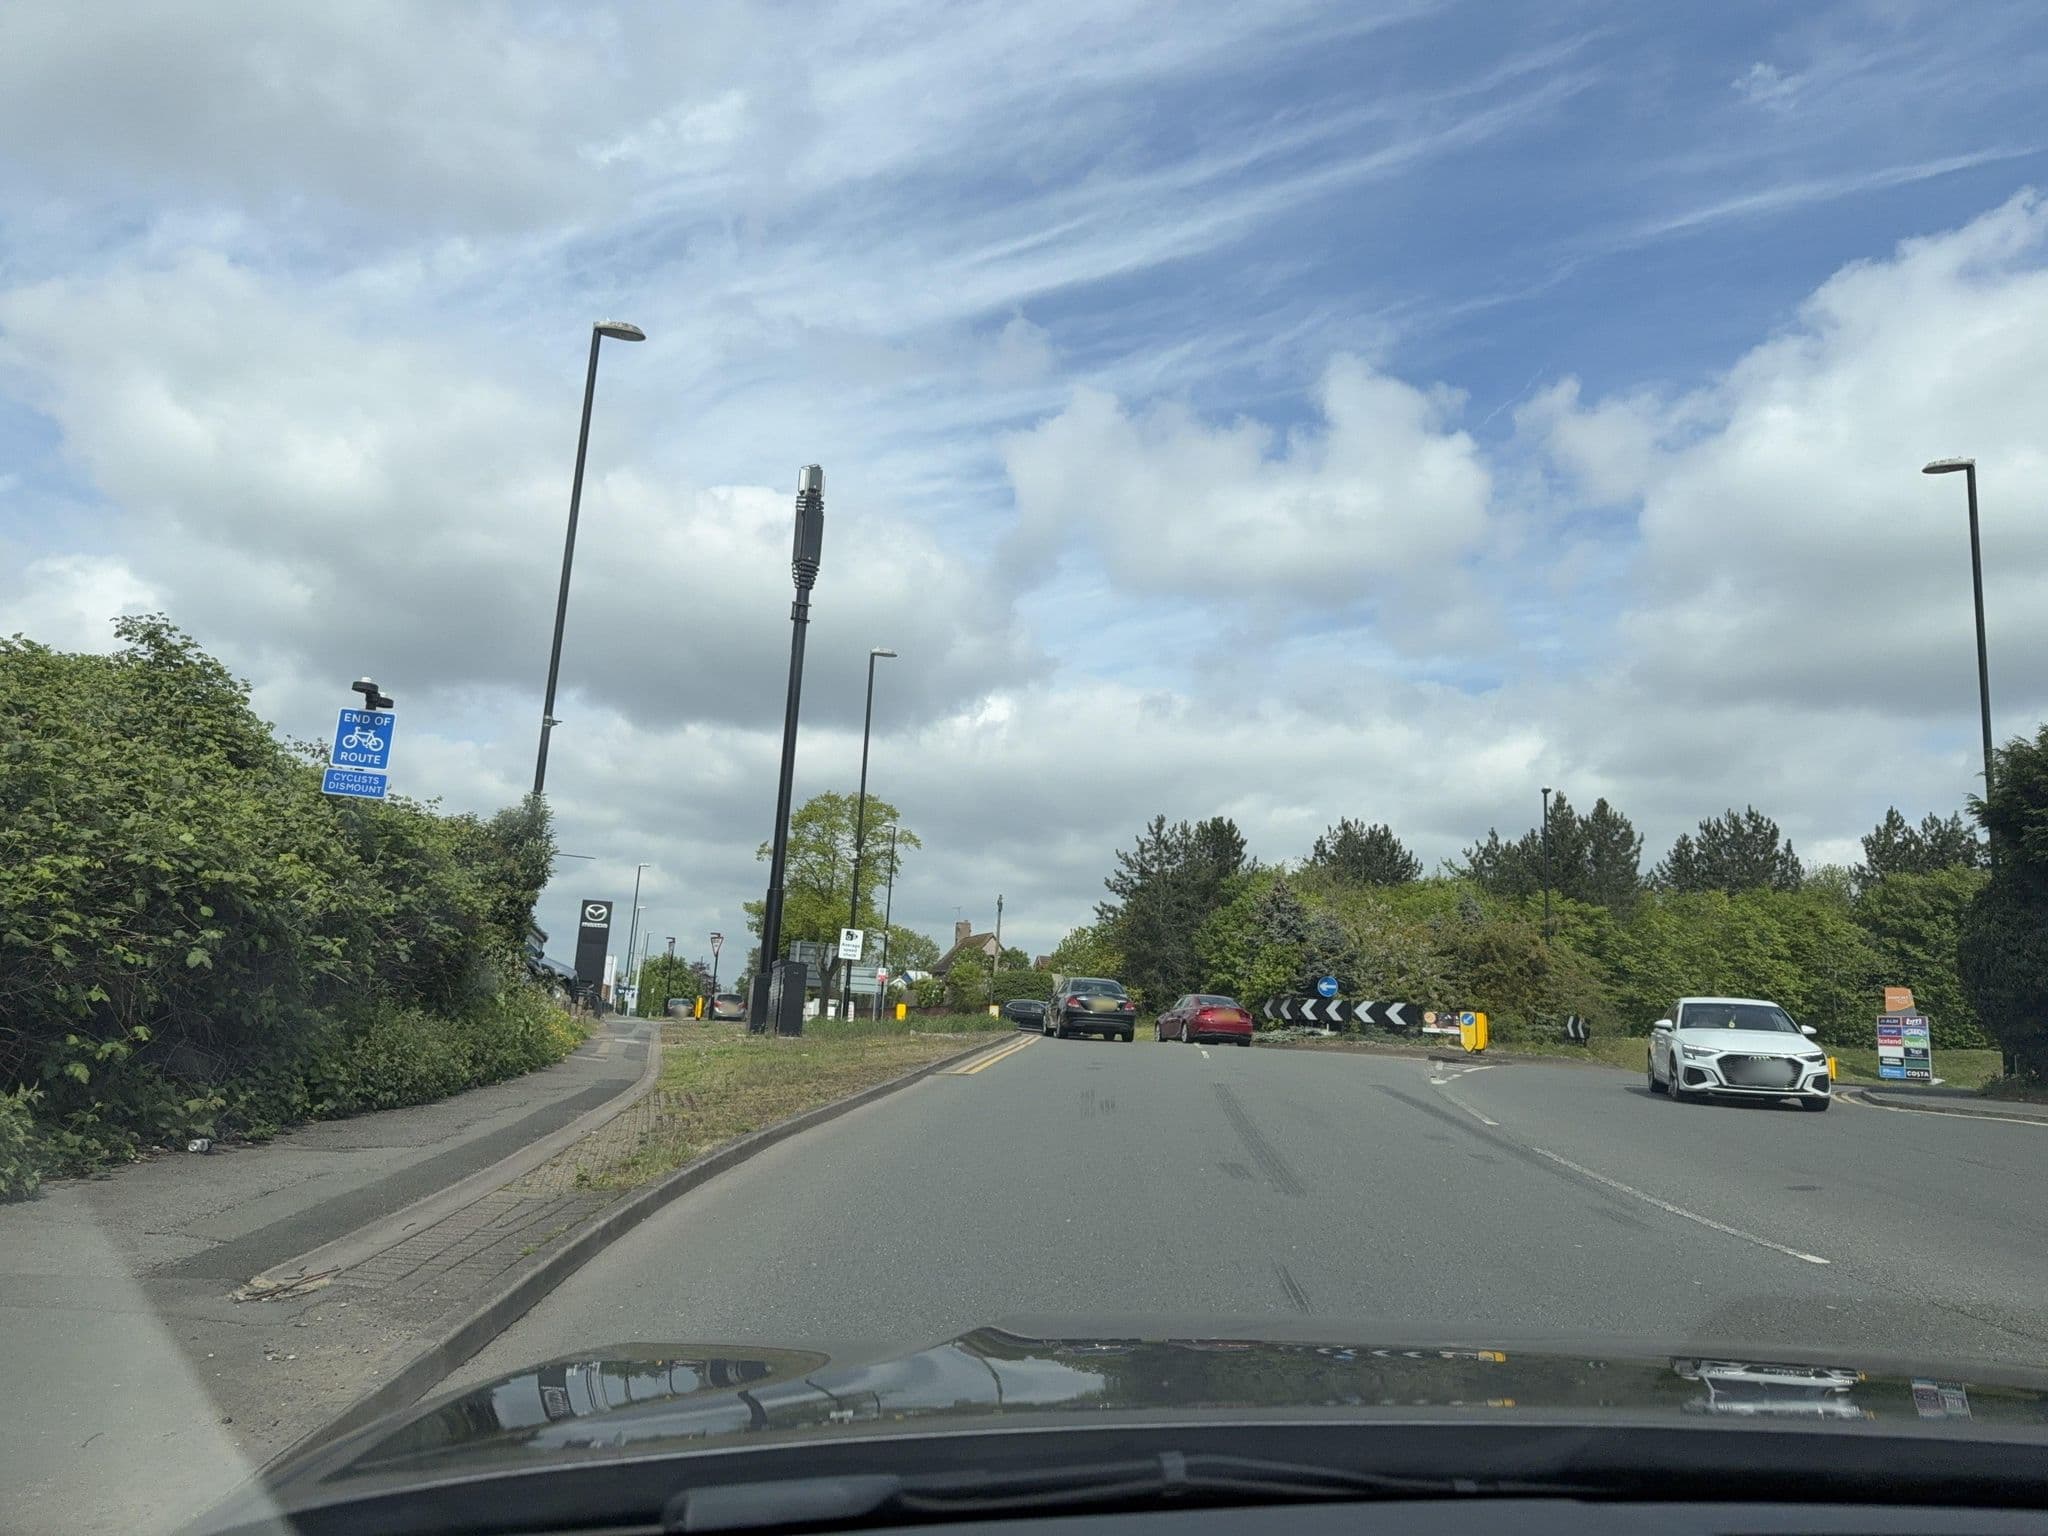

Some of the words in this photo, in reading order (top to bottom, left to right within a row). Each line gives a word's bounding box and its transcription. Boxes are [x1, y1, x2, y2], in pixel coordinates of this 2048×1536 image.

[344, 712, 371, 724] END
[374, 716, 392, 727] OF
[340, 752, 382, 765] ROUTE
[333, 773, 380, 785] CYCLISTS
[328, 782, 383, 794] DISMOUNT
